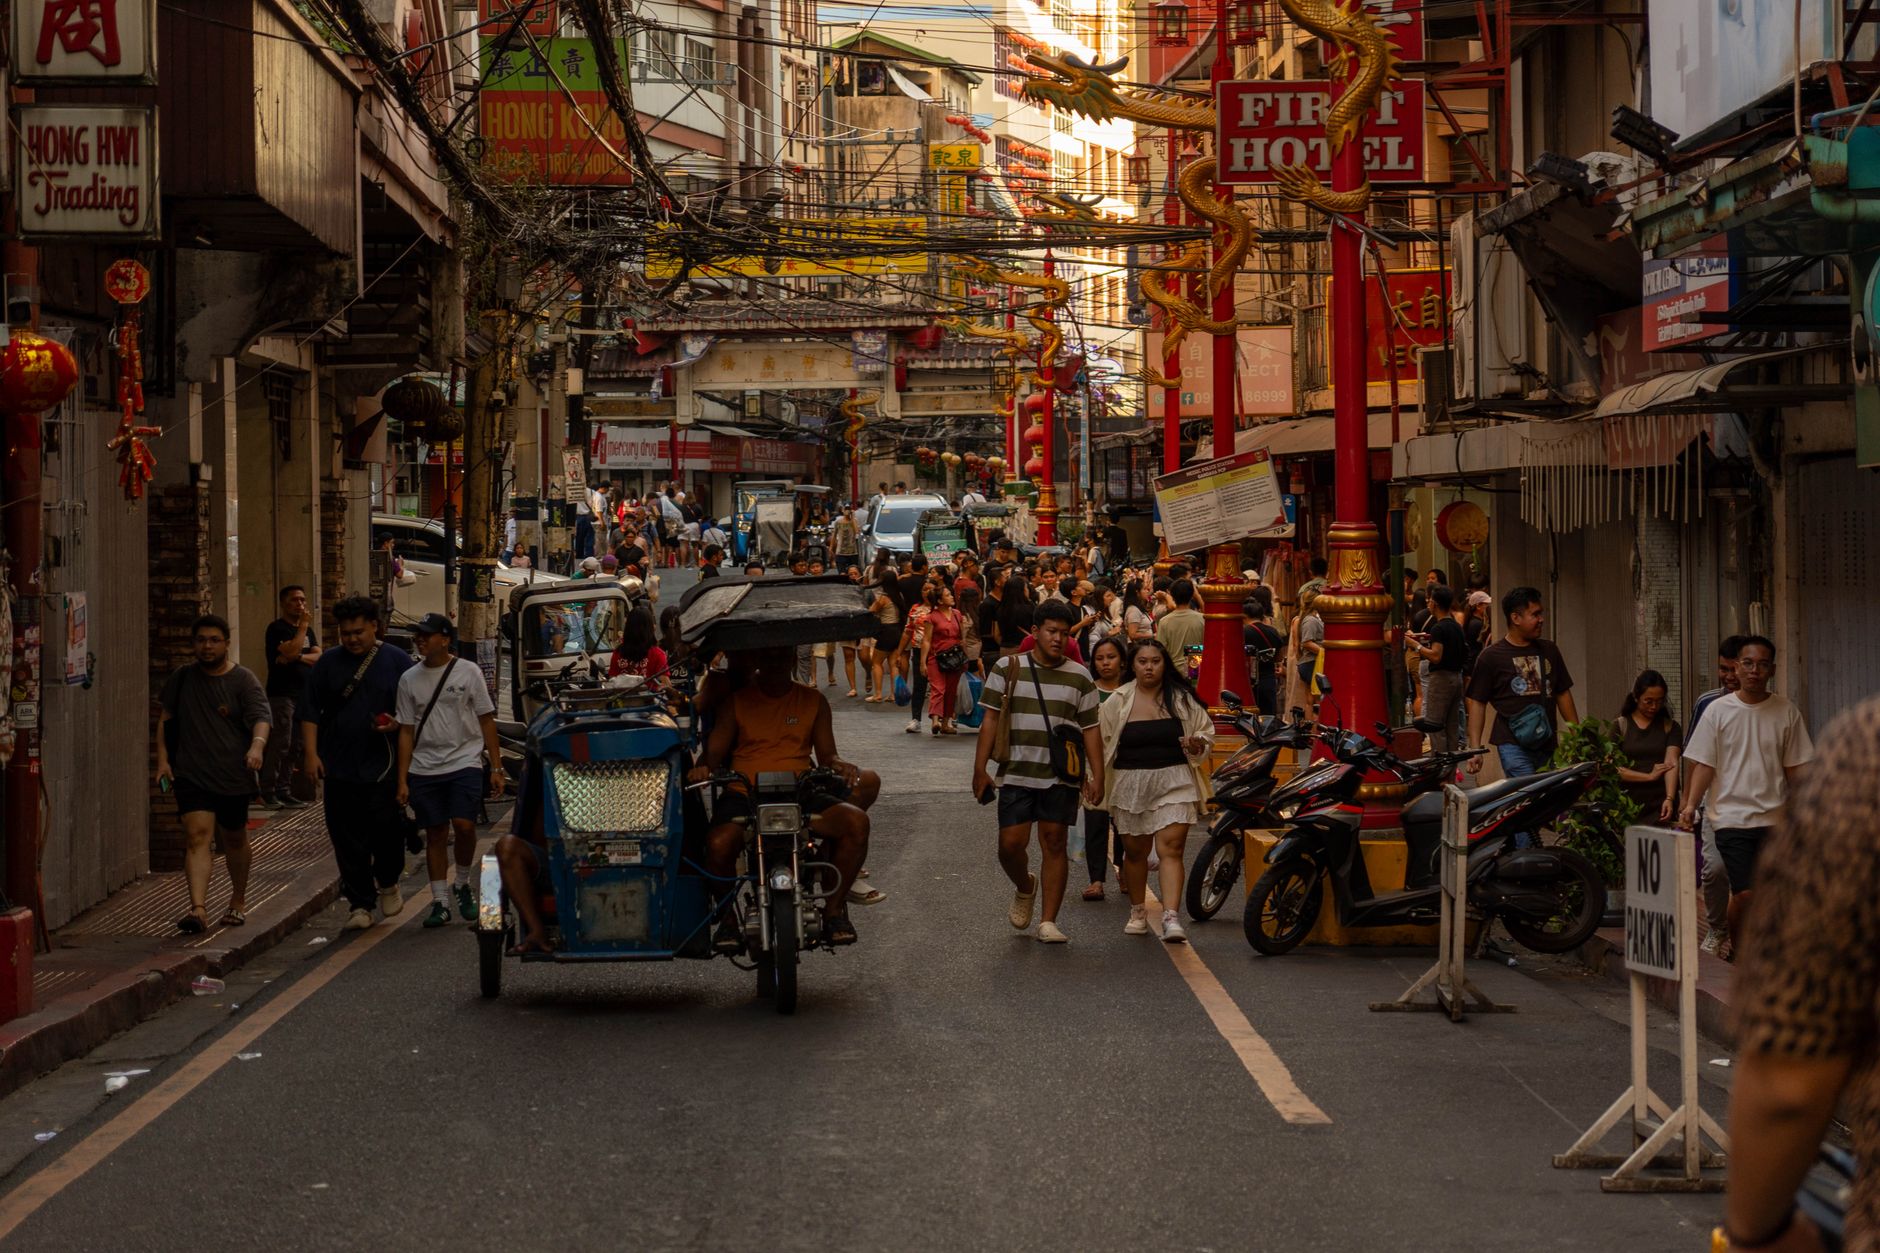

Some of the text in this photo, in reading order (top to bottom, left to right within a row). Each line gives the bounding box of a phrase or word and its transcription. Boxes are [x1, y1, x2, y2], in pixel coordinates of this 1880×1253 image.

[487, 102, 626, 141] HONG KONG
[1237, 90, 1405, 127] FIRT
[27, 125, 139, 167] HONG HWI
[28, 171, 139, 227] Trading
[608, 438, 657, 461] mercury drug
[1470, 797, 1532, 834] CLICK
[1638, 837, 1660, 895] NO
[1627, 906, 1676, 970] PARKING
